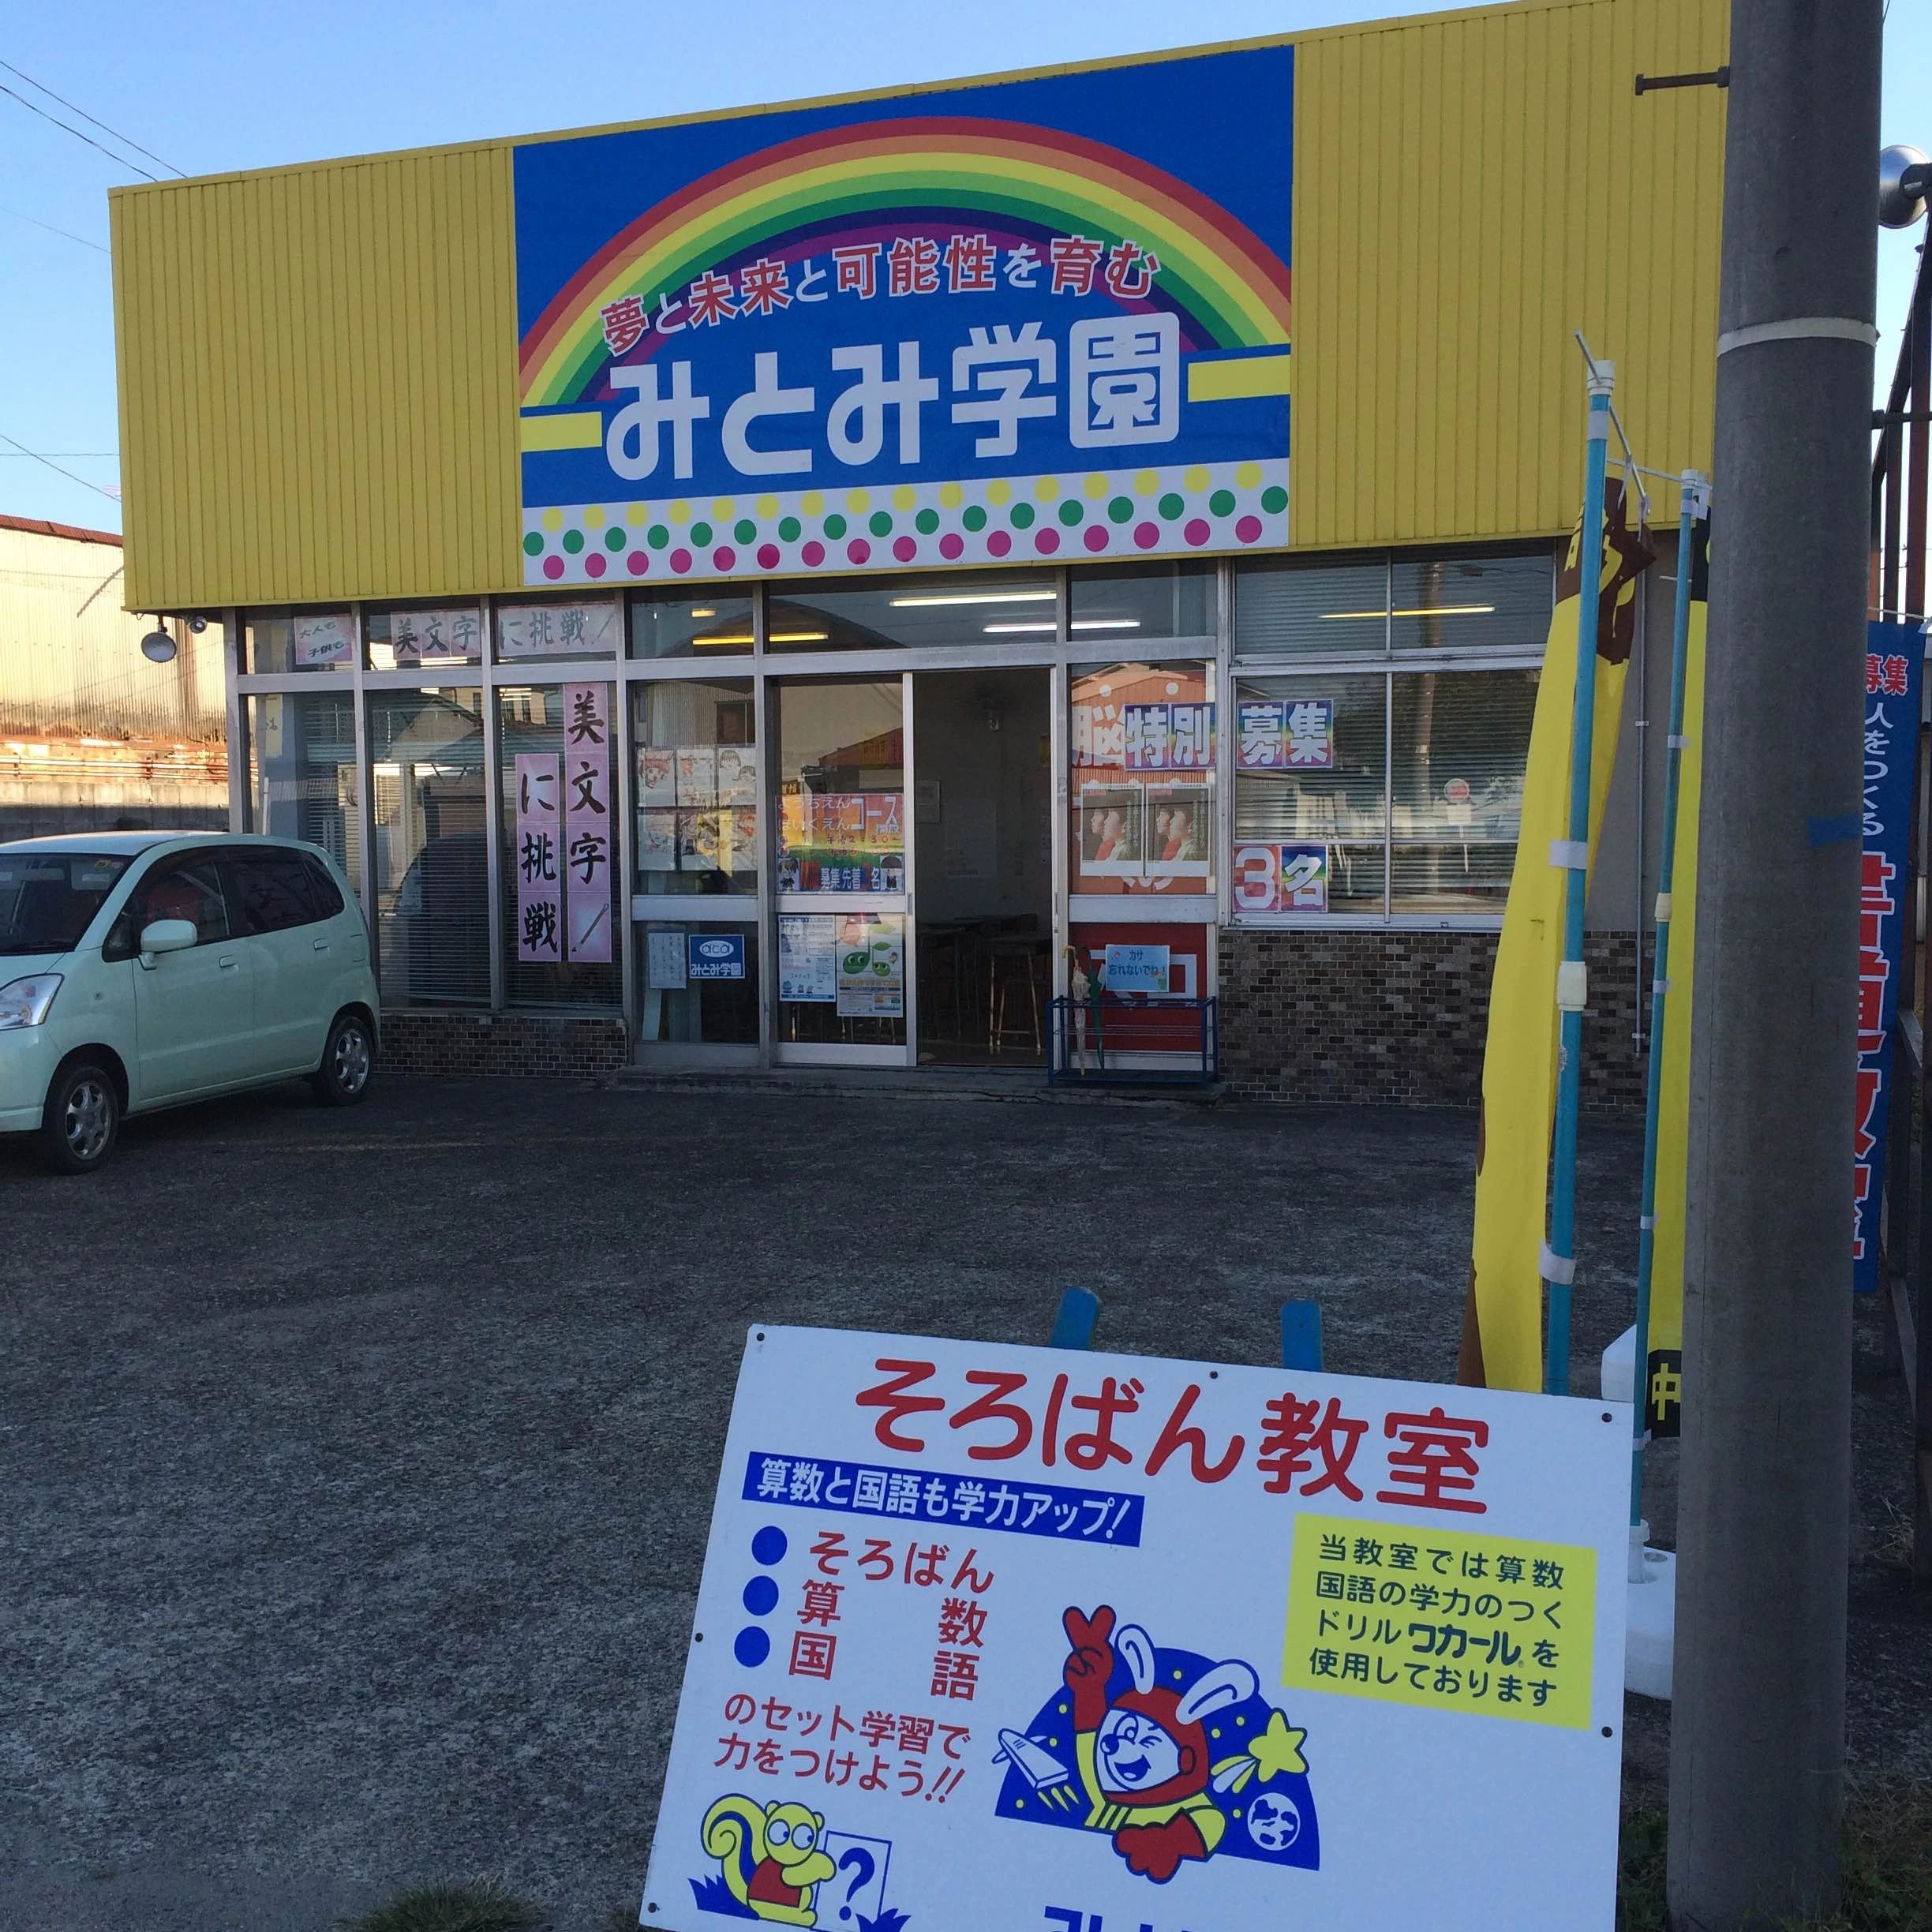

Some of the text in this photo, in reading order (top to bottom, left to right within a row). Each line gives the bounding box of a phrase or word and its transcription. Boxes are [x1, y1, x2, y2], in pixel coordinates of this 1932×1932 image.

[602, 234, 1161, 358] 夢と未来と可能性を育む
[605, 312, 1179, 480] みとみ学園
[1126, 702, 1328, 767] 特別 募集
[521, 773, 559, 953] に挑戦
[1235, 848, 1324, 909] 3名
[856, 1358, 1489, 1515] そろばん教室
[756, 1457, 1129, 1540] 算数と国語も学力アップ!
[809, 1531, 995, 1593] そろばん
[1320, 1533, 1564, 1590] 当教室では算数
[1316, 1571, 1562, 1630] 国語の学力のつく
[1309, 1646, 1557, 1707] 使用しております
[724, 1692, 972, 1762] のセット学習で
